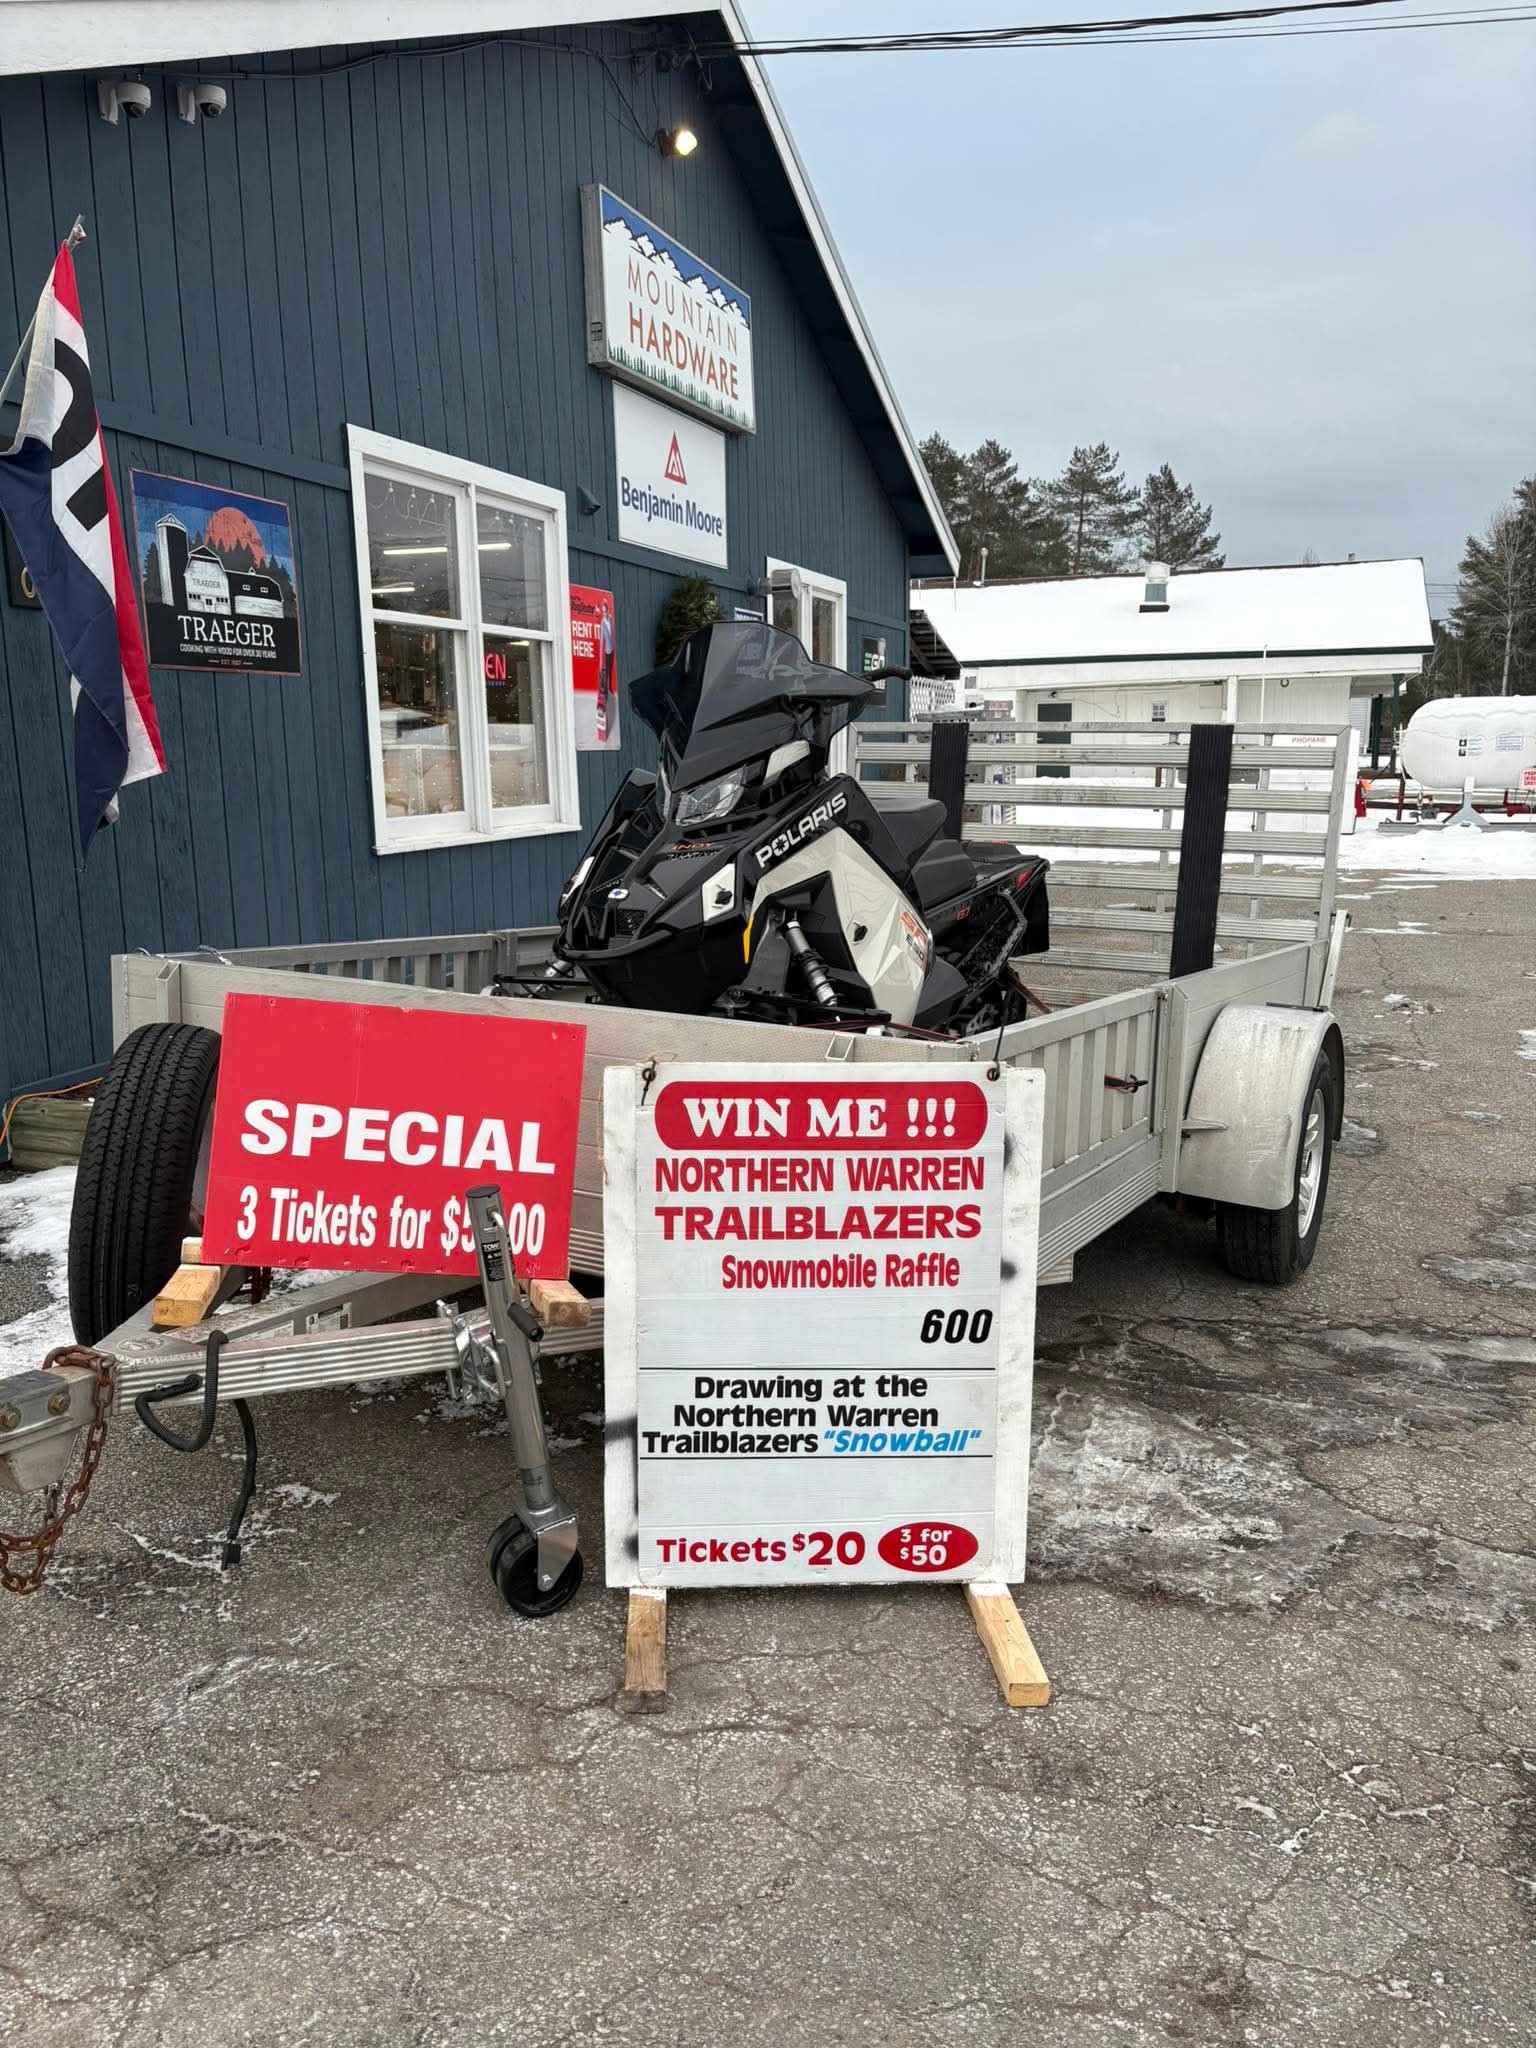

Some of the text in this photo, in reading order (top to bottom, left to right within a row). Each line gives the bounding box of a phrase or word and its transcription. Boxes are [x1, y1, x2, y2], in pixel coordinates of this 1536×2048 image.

[627, 254, 738, 355] MOUNTAIN
[629, 302, 739, 400] HARDWARE
[621, 476, 723, 537] Benjamin Moore
[192, 577, 221, 590] TRAEGER
[177, 614, 276, 648] TRAEGER
[572, 620, 601, 640] RENT IT
[180, 643, 204, 654] COOKING
[204, 646, 218, 655] WITH
[218, 647, 233, 656] WOOD
[233, 648, 243, 657] FOR
[243, 649, 255, 658] OVER
[262, 650, 277, 659] YEARS
[573, 639, 595, 658] HERE
[485, 654, 507, 680] EN
[754, 791, 848, 870] POLARIS
[683, 1097, 957, 1138] WIN ME !!!
[241, 1098, 556, 1175] SPECIAL
[655, 1156, 985, 1193] NORTHERN WARREN
[237, 1184, 546, 1256] 3 Tickets for $500
[654, 1203, 982, 1241] TRAILBLAZERS
[721, 1252, 961, 1289] Snowmobile Raffle
[920, 1308, 994, 1344] 600
[694, 1375, 928, 1402] Drawing at the
[673, 1404, 939, 1427] Northern Warren
[642, 1429, 983, 1454] Trailblazers "Snowball"
[656, 1531, 866, 1566] Tickets $20
[900, 1528, 953, 1543] 3 for
[899, 1545, 948, 1566] $50
